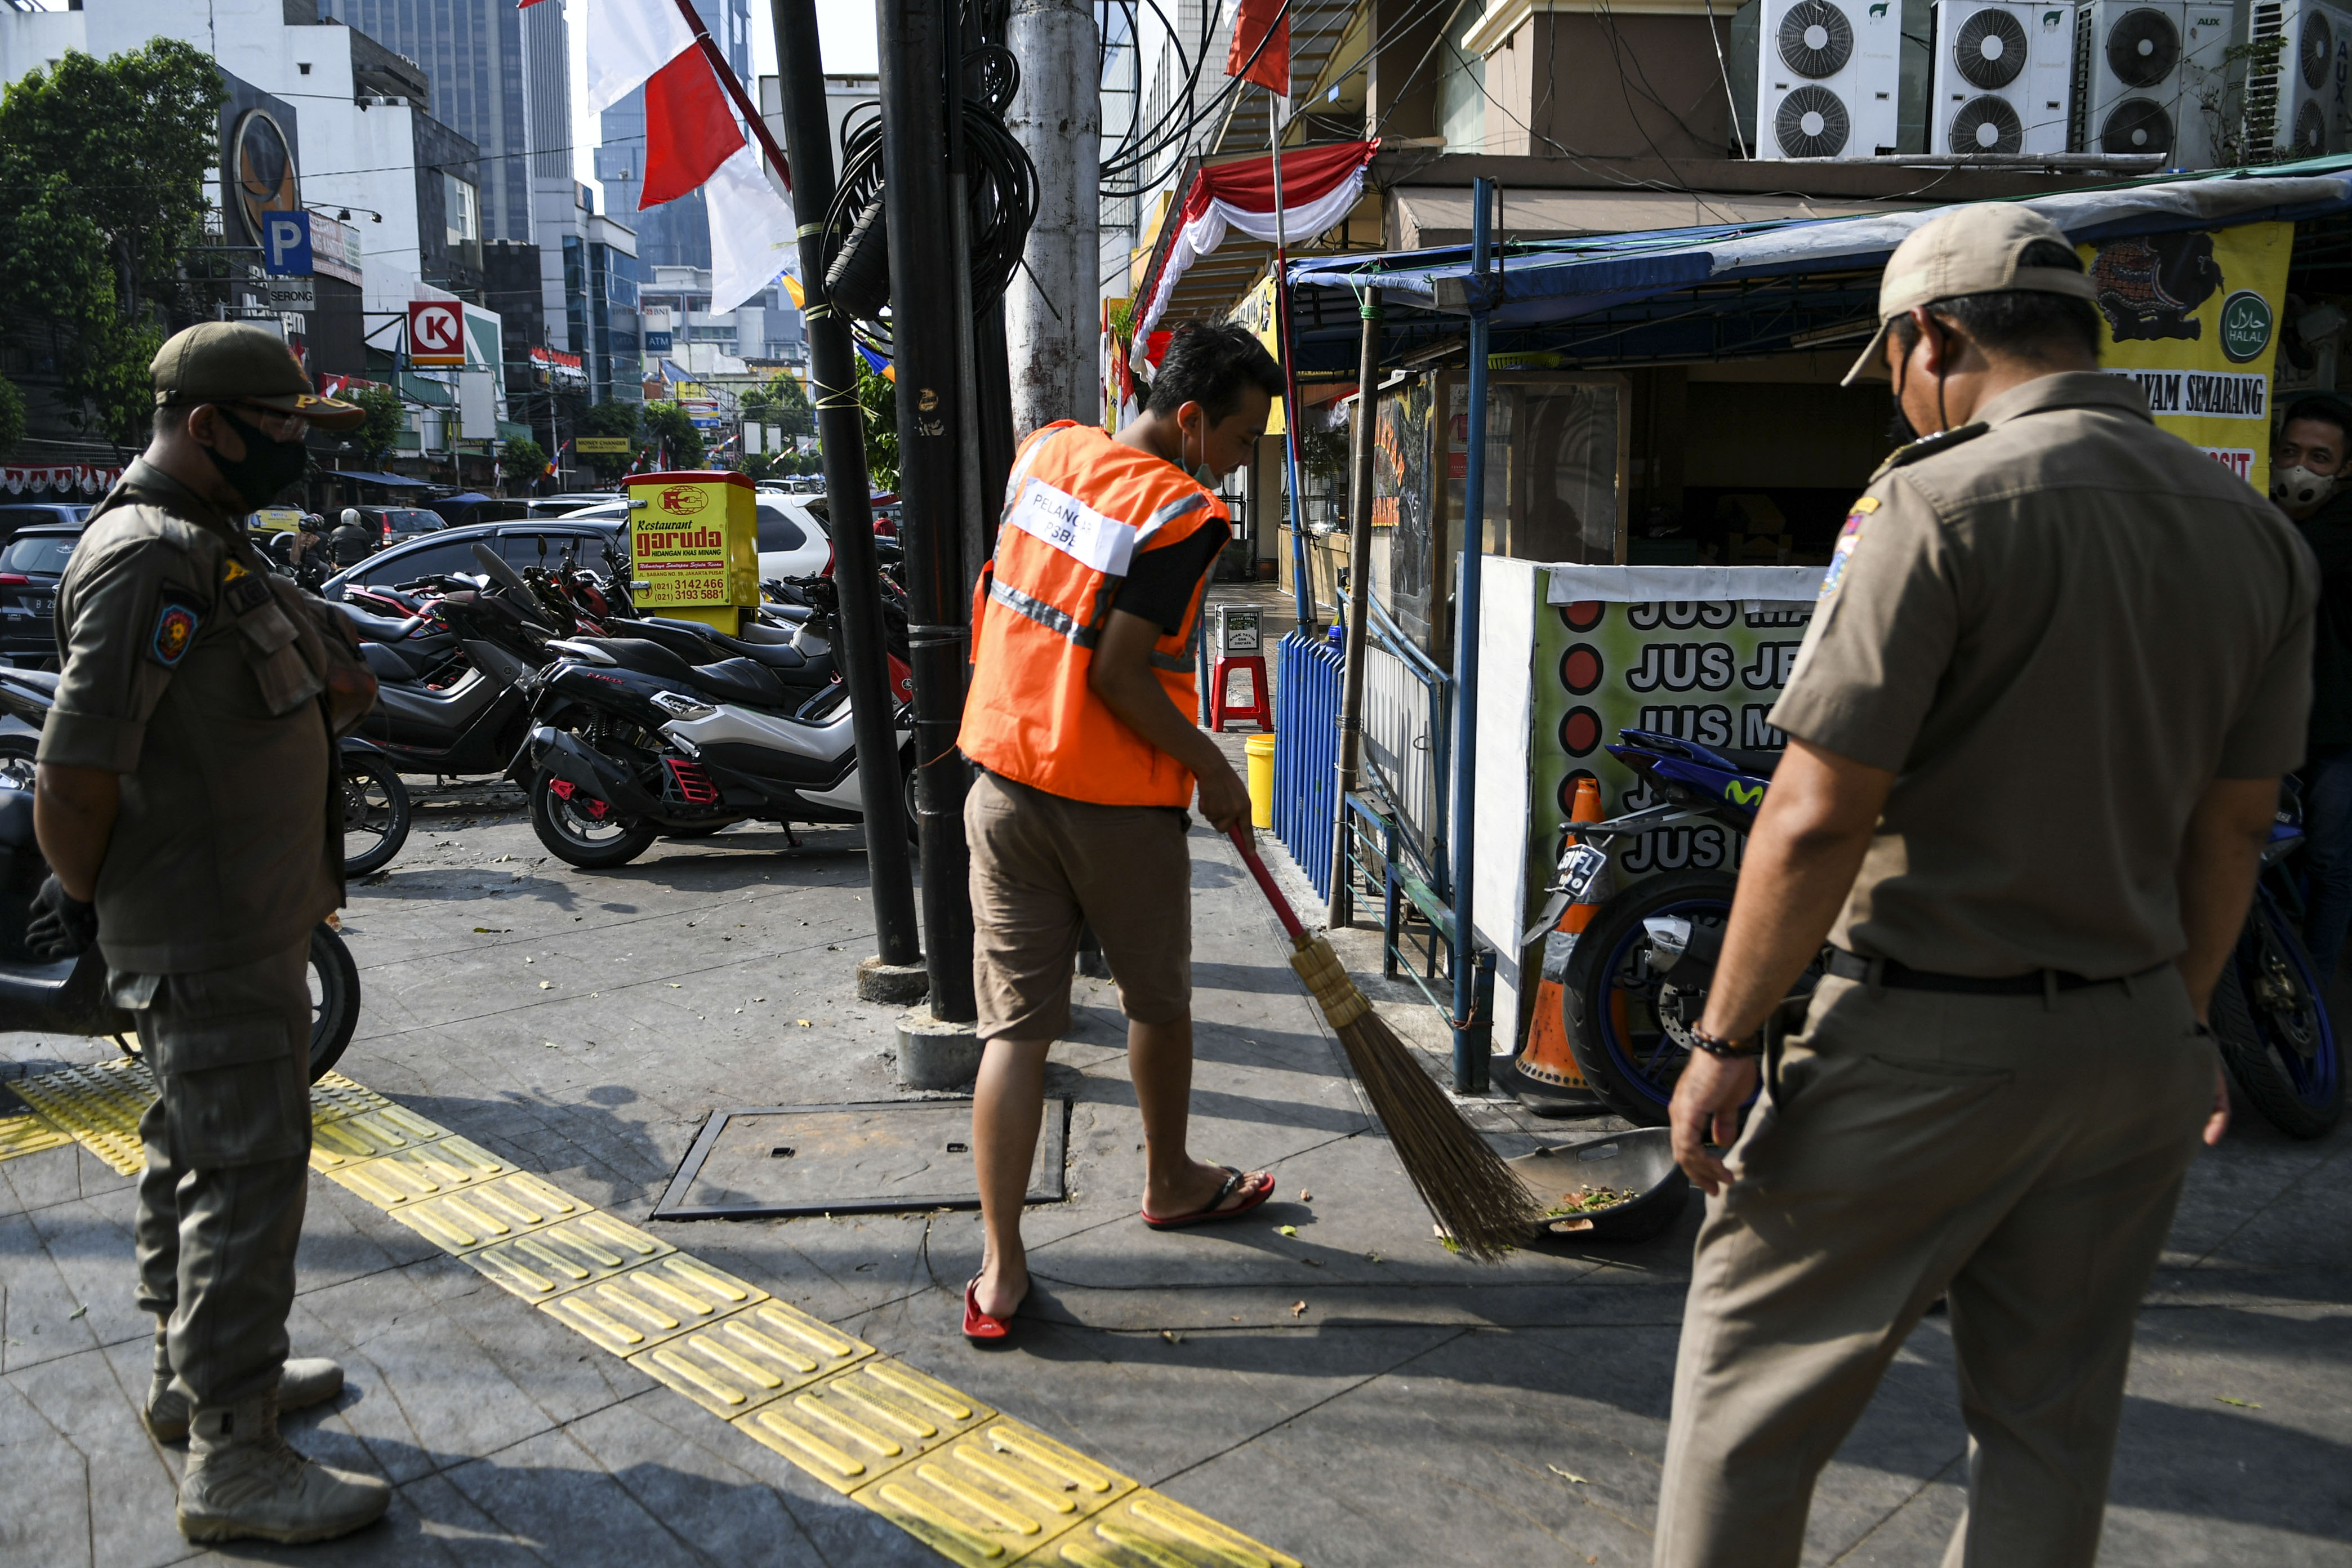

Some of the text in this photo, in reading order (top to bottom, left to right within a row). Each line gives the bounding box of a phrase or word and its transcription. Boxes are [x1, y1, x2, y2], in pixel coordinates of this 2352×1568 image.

[2335, 41, 2349, 105] AUX
[271, 220, 302, 266] P
[270, 291, 313, 301] SERONG
[2230, 307, 2266, 329] حلال
[426, 316, 455, 347] K
[2229, 330, 2263, 342] HALAL
[648, 337, 669, 346] ATM
[2136, 373, 2263, 415] YAM SEMARANG
[637, 520, 693, 531] Restaurant
[654, 579, 724, 591] (021) 3142 466
[675, 590, 698, 600] 3193
[701, 589, 724, 599] 5881
[36, 599, 42, 609] B
[1230, 632, 1255, 642] ANAK YATIM
[1627, 643, 1734, 691] JUS
[1621, 825, 1725, 873] JUS
